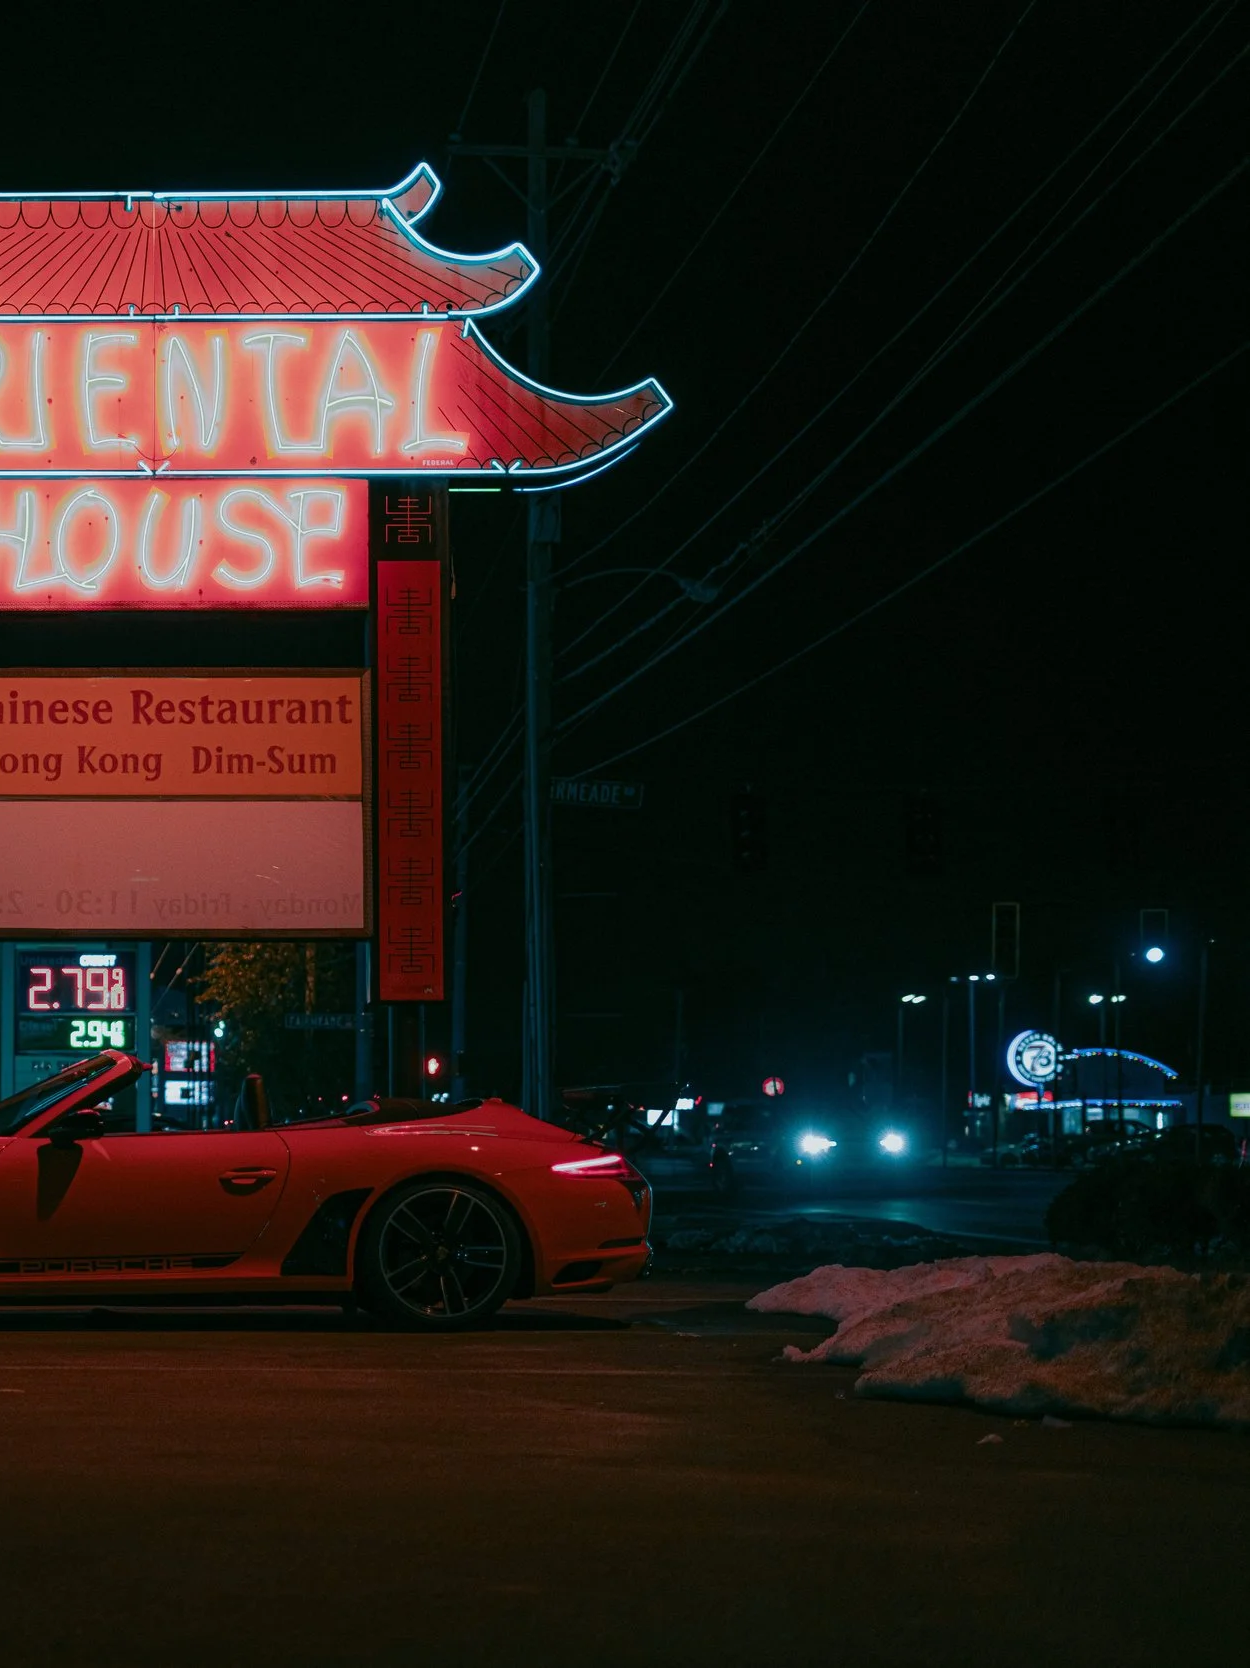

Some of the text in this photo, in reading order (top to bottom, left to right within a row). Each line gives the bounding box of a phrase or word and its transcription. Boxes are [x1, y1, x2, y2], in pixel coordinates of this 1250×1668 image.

[422, 459, 455, 467] FEDERAL
[130, 690, 353, 726] Restaurant
[77, 745, 163, 781] Kong
[191, 745, 337, 775] Dim-Sum
[19, 1256, 193, 1273] PORSCHE
